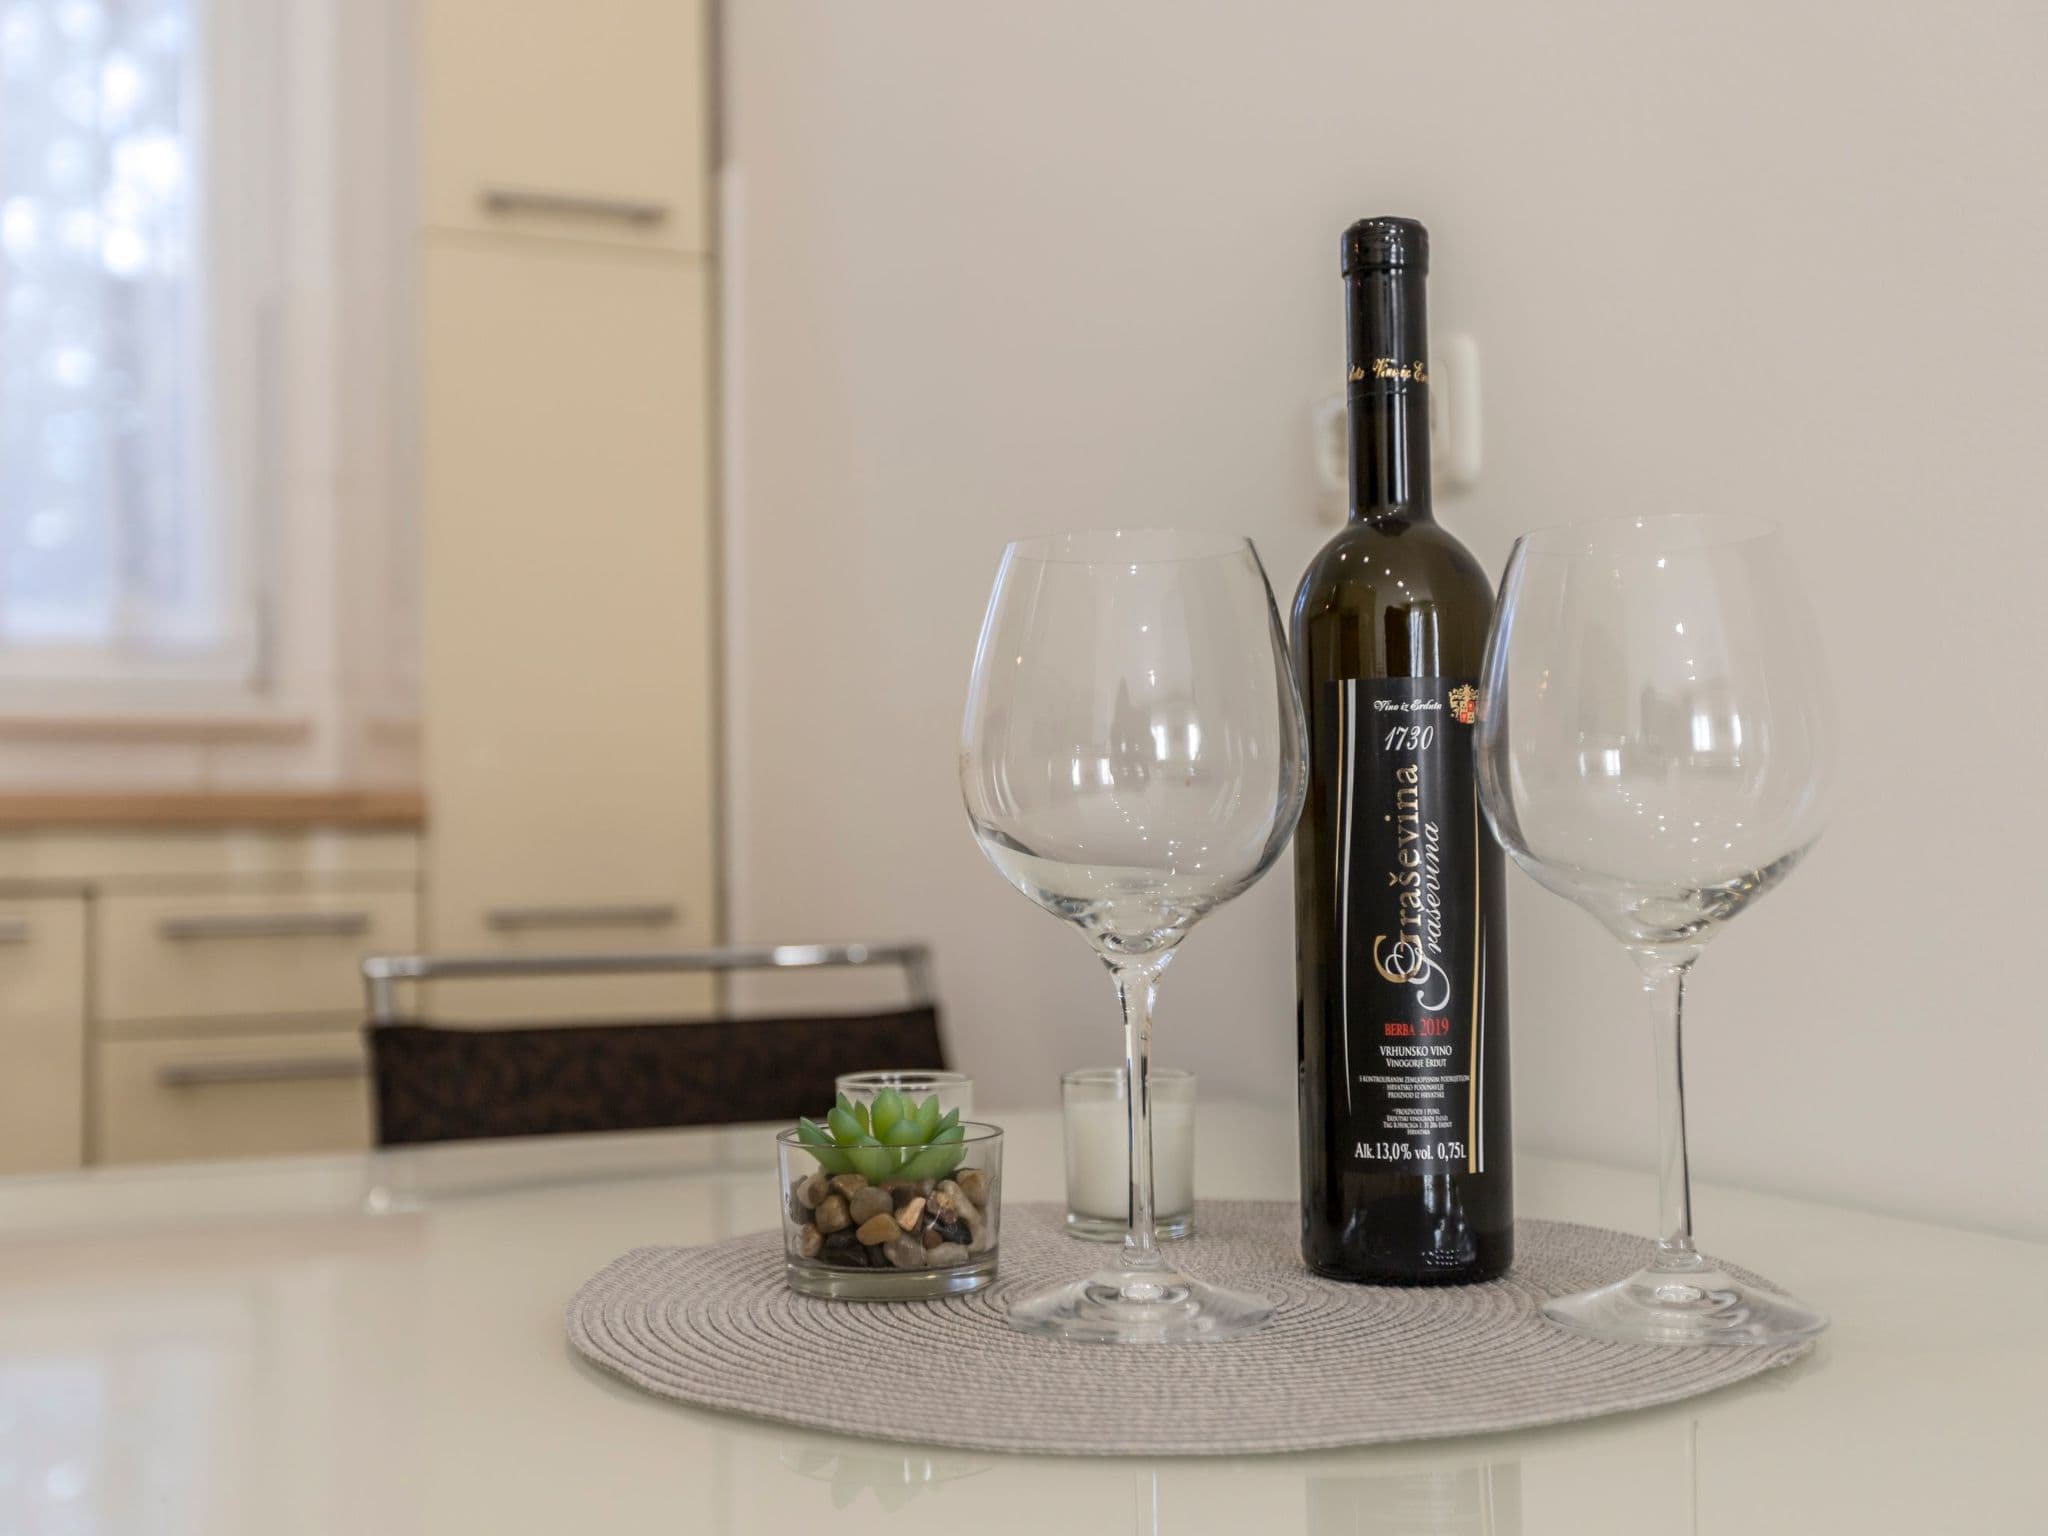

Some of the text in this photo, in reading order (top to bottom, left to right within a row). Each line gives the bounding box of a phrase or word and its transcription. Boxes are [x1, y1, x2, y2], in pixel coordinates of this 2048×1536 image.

[1373, 699, 1400, 712] Vino
[1401, 701, 1409, 712] iz
[1384, 725, 1434, 751] 1730
[1373, 763, 1424, 984] Graševina
[1384, 1018, 1450, 1036] BERBA 2019
[1380, 1045, 1453, 1057] VRHUNSKO VINO
[1415, 1144, 1434, 1160] vol.
